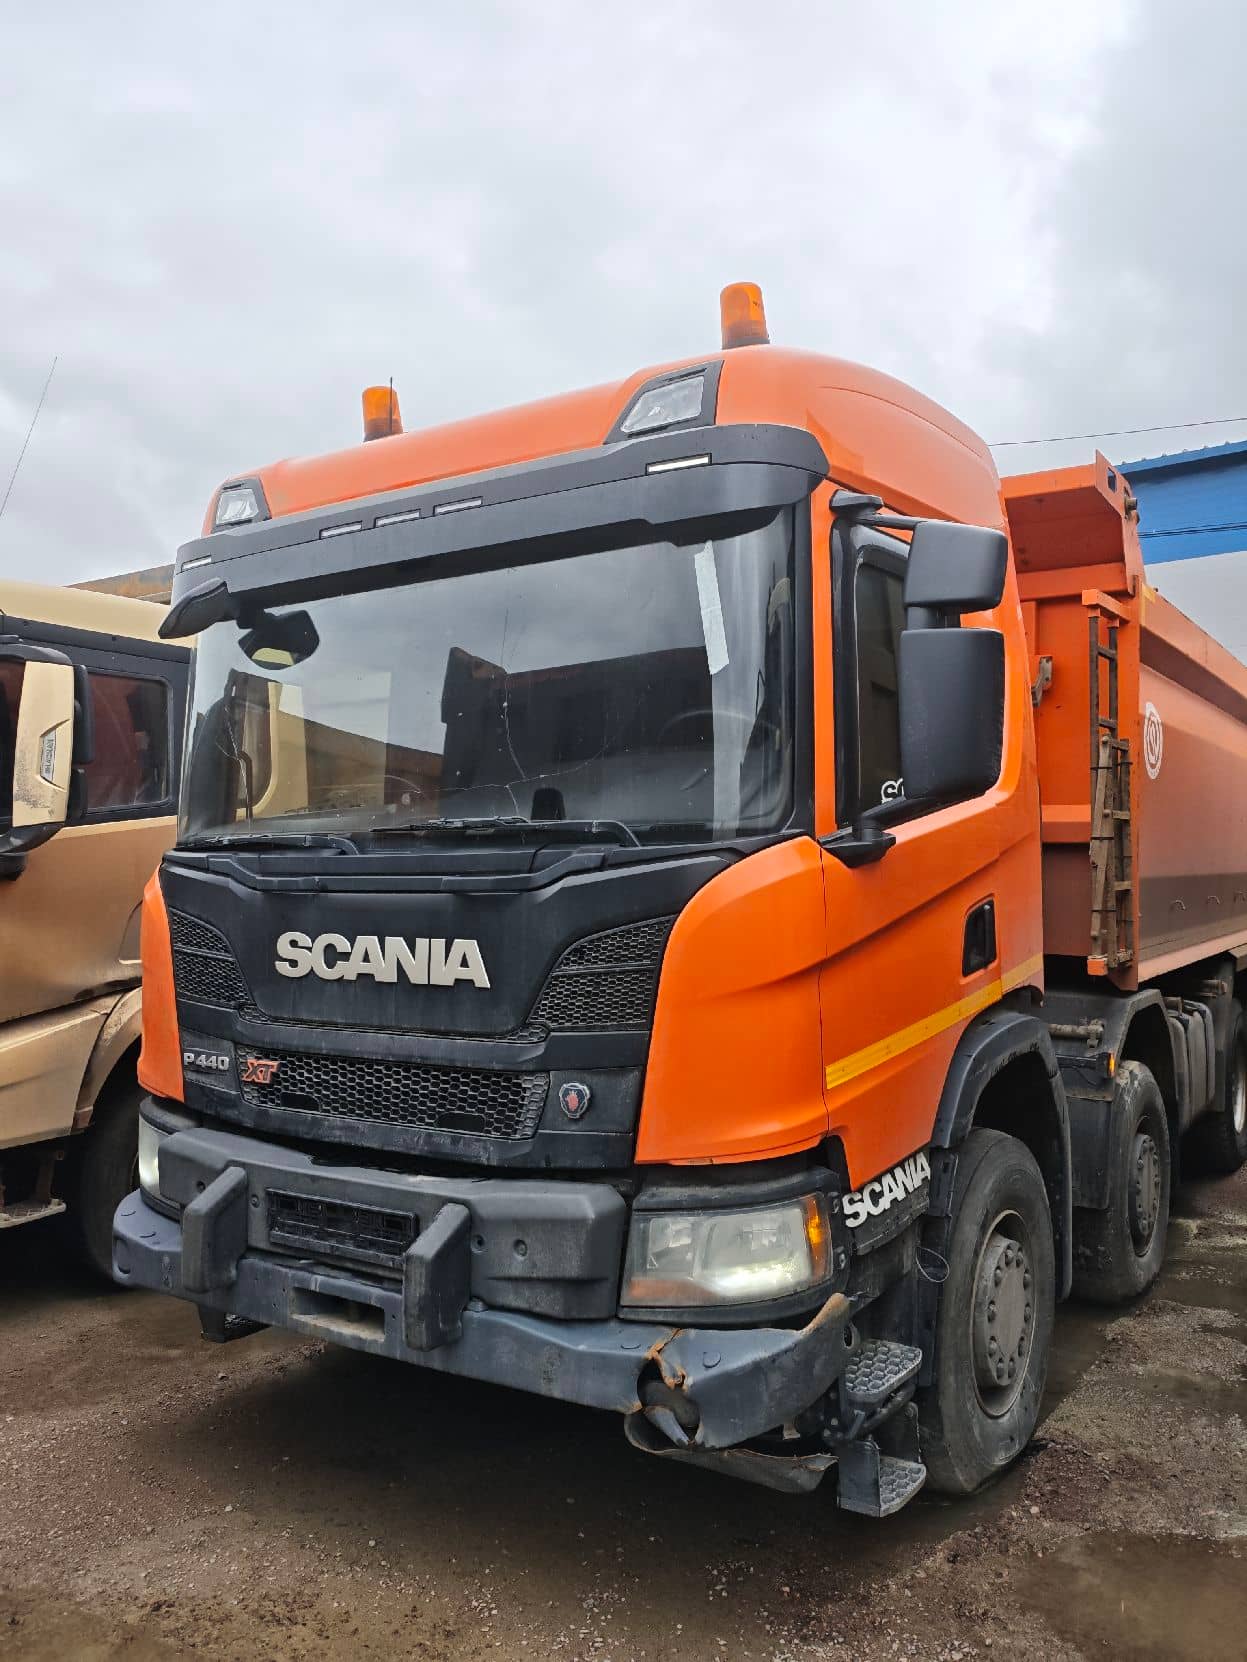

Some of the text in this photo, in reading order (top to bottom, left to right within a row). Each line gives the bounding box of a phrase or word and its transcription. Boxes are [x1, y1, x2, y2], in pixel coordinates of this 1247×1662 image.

[275, 931, 490, 989] SCANIA
[242, 1058, 280, 1084] XT
[842, 1151, 931, 1228] SCANIA
